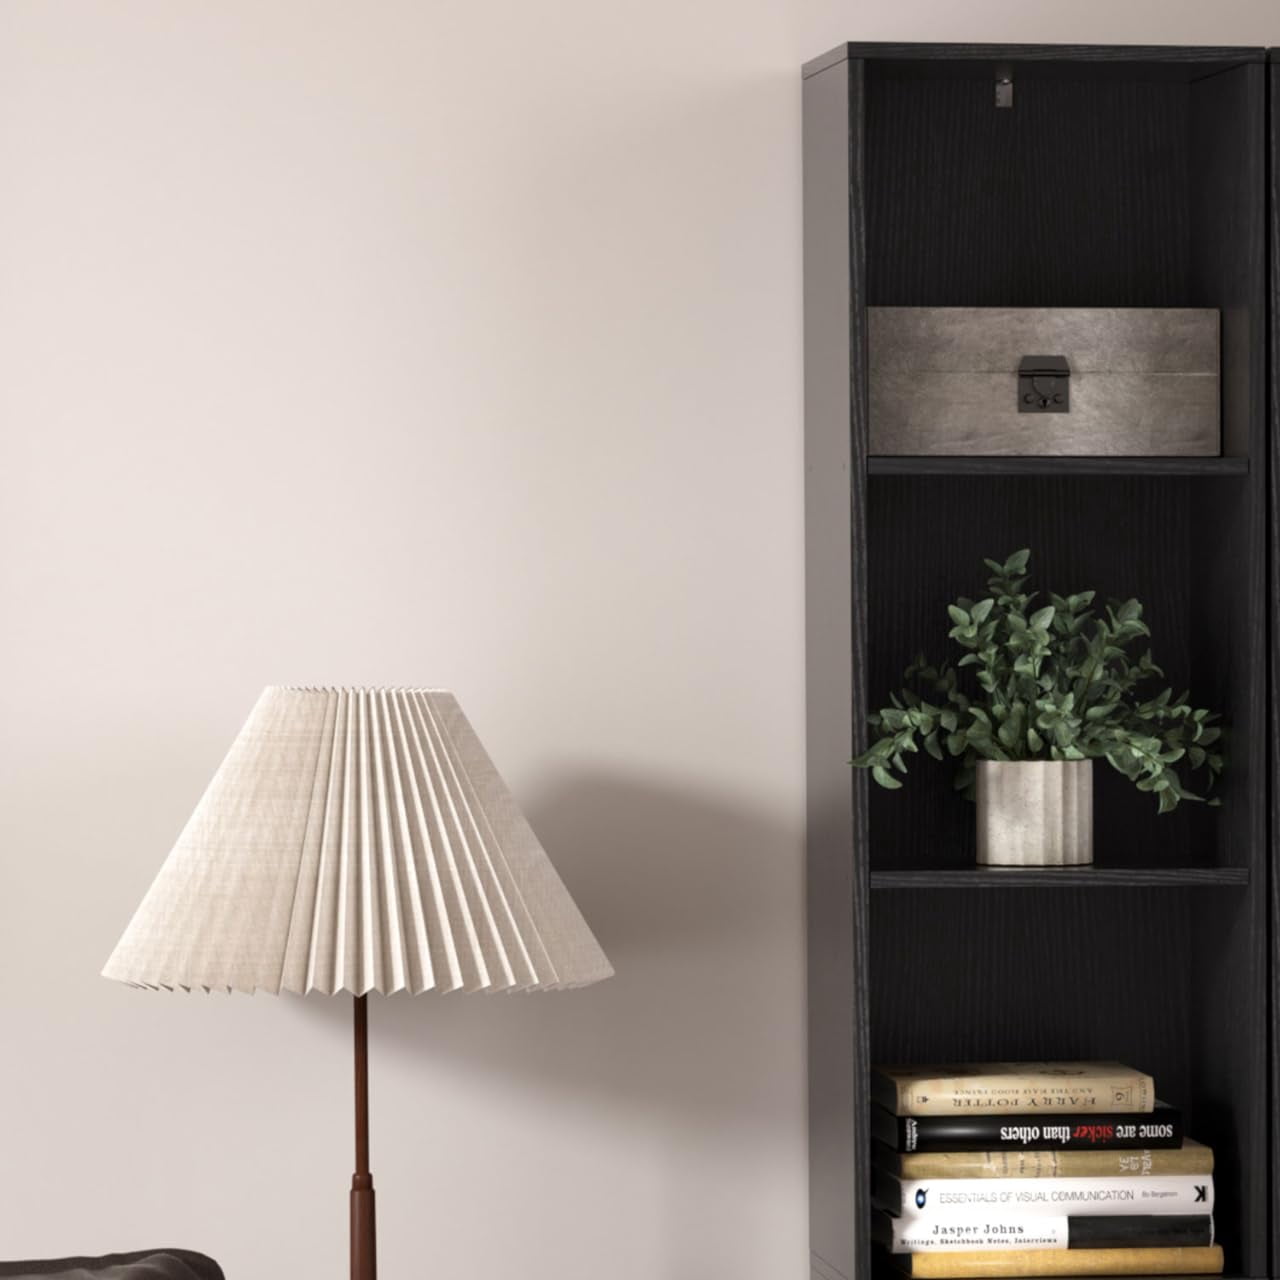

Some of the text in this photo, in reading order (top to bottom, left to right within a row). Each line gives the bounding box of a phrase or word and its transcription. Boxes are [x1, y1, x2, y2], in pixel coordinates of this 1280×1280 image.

[952, 1096, 1096, 1108] HARRY POTTER
[1001, 1125, 1173, 1144] some are sicker than others
[939, 1192, 997, 1203] ESSENTIALS
[1000, 1191, 1014, 1203] OF
[1016, 1191, 1048, 1202] VISUAL
[1051, 1190, 1134, 1201] COMMUNICATION
[1194, 1186, 1207, 1202] K
[932, 1223, 1025, 1237] Jasper Johns
